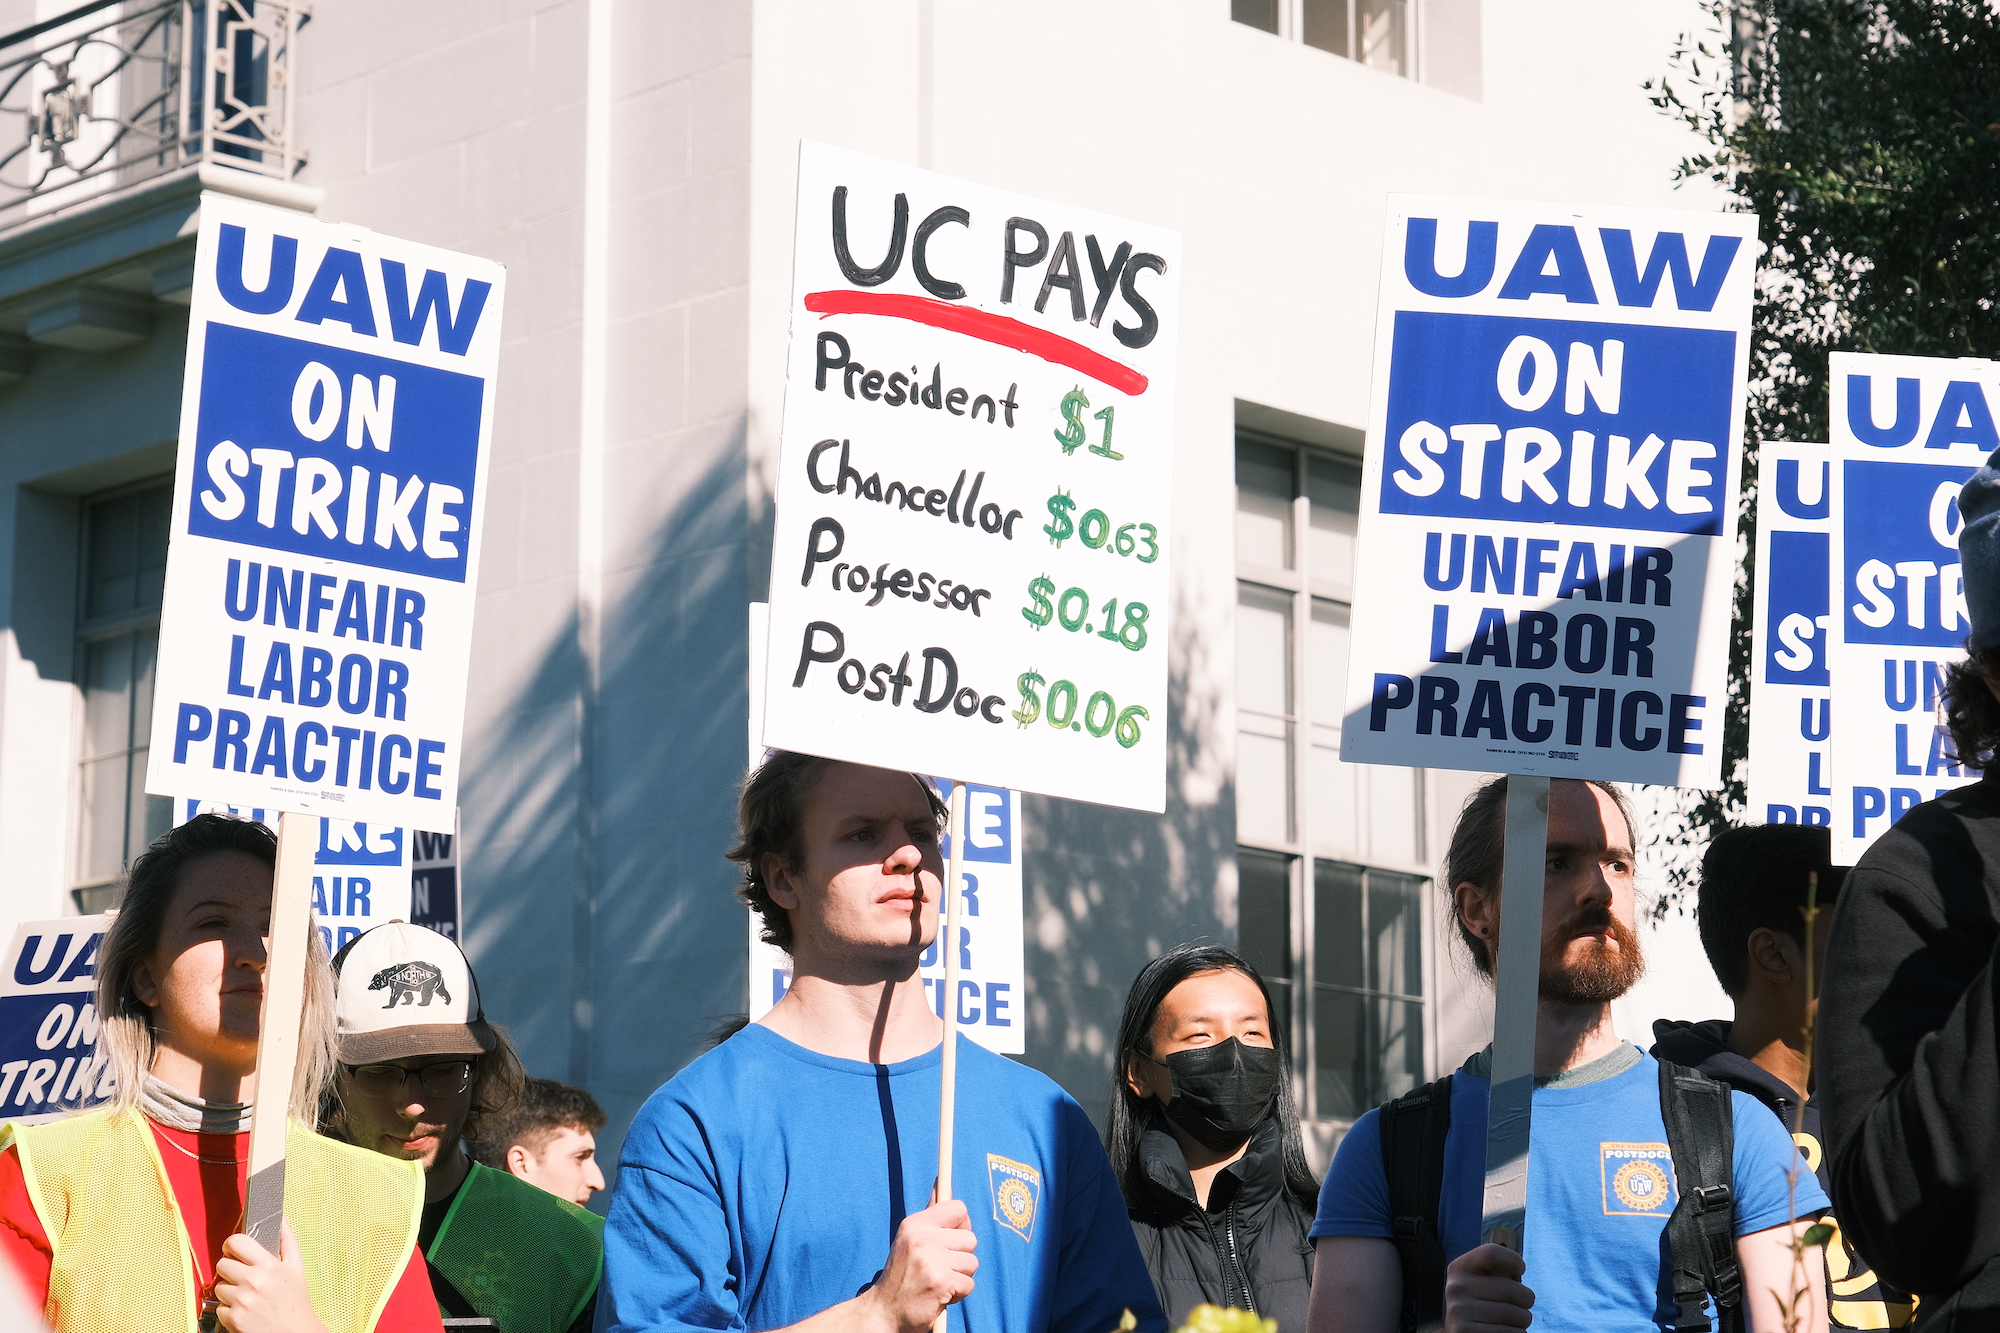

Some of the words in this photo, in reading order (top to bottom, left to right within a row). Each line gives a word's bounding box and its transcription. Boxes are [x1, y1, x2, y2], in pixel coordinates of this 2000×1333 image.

[215, 222, 492, 357] UAW
[832, 185, 971, 299] UC
[1000, 216, 1168, 349] PAYS
[1403, 216, 1743, 313] UAW
[291, 361, 397, 453] ON
[815, 331, 1019, 428] President
[1053, 384, 1125, 461] $1
[1496, 335, 1625, 417] ON
[1847, 374, 2000, 453] UA
[200, 440, 465, 560] STRIKE
[806, 438, 1023, 541] Chancellor
[1043, 485, 1159, 564] $0.63
[1392, 420, 1717, 515] STRIKE
[1929, 480, 1965, 551] O
[224, 558, 426, 651] UNFAIR
[800, 516, 992, 618] Professor
[1021, 572, 1151, 652] $0.18
[1423, 532, 1674, 608] UNFAIR
[1852, 558, 1972, 633] STR
[226, 634, 410, 722] LABOR
[1429, 604, 1656, 679] LABOR
[1011, 666, 1151, 749] $0.06
[1369, 672, 1707, 756] PRACTICE
[172, 702, 447, 801] PRACTICE
[311, 876, 371, 917] AIR
[14, 933, 105, 986] UA
[401, 970, 427, 981] NORTH
[0, 1056, 117, 1108] TRIKE
[1397, 1095, 1430, 1109] CHROME
[1604, 1149, 1672, 1160] POSTDOCS
[1629, 1179, 1653, 1196] UAW
